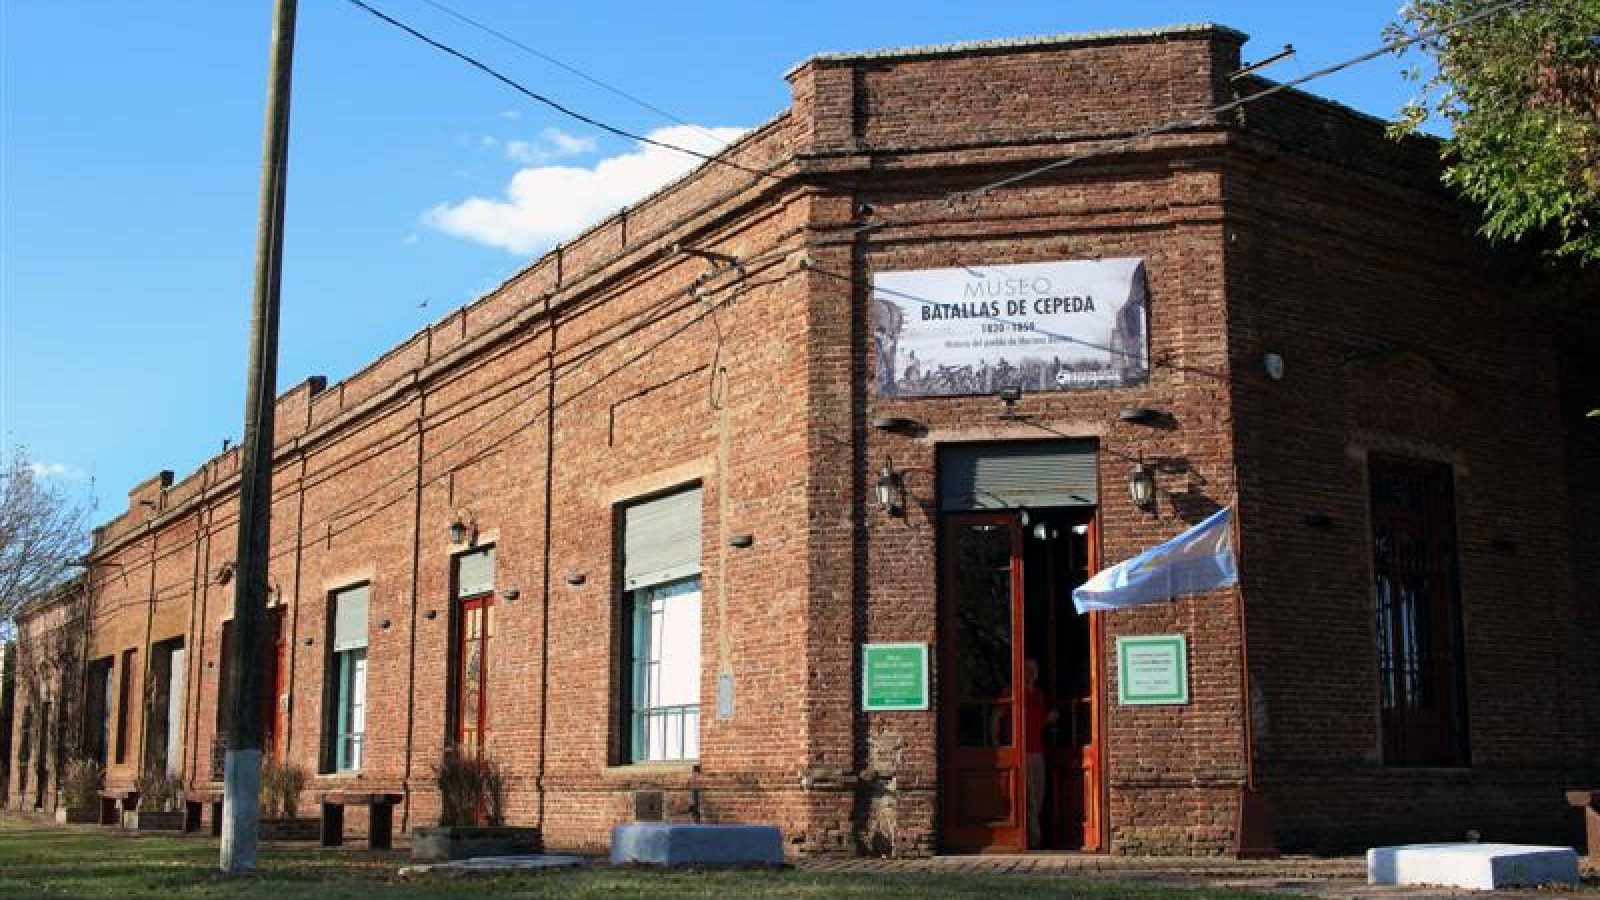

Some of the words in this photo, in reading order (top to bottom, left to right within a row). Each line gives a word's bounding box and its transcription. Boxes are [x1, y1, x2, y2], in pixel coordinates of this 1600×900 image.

[964, 277, 1052, 298] MUSEO
[921, 301, 1000, 321] BATALLAS
[1007, 299, 1027, 317] DE
[1033, 296, 1096, 315] CEPEDA
